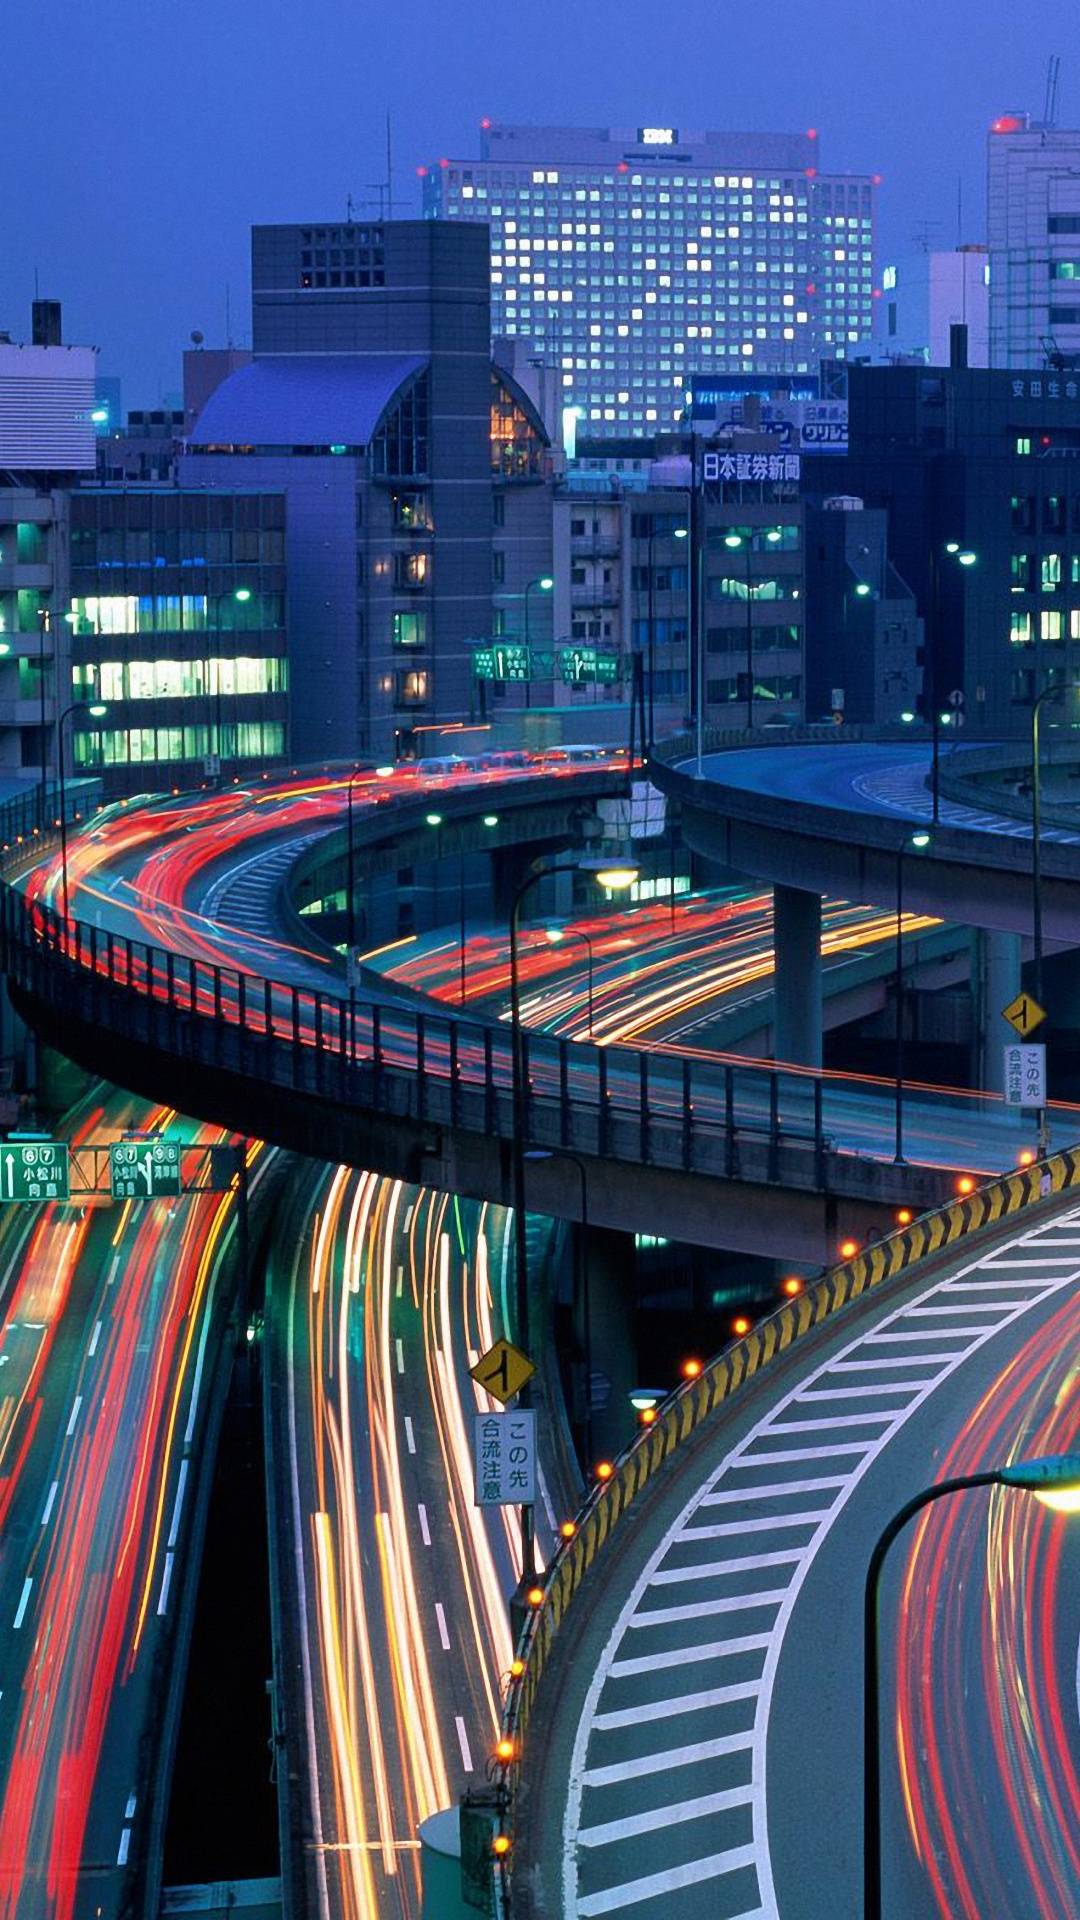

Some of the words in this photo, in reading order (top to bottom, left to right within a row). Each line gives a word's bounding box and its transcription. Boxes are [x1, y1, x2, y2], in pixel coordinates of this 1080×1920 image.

[704, 453, 800, 480] 日本証券新聞
[1026, 1051, 1040, 1097] この先
[23, 1167, 62, 1181] 小松川
[481, 1418, 502, 1500] 合流注意
[508, 1422, 529, 1488] この先
